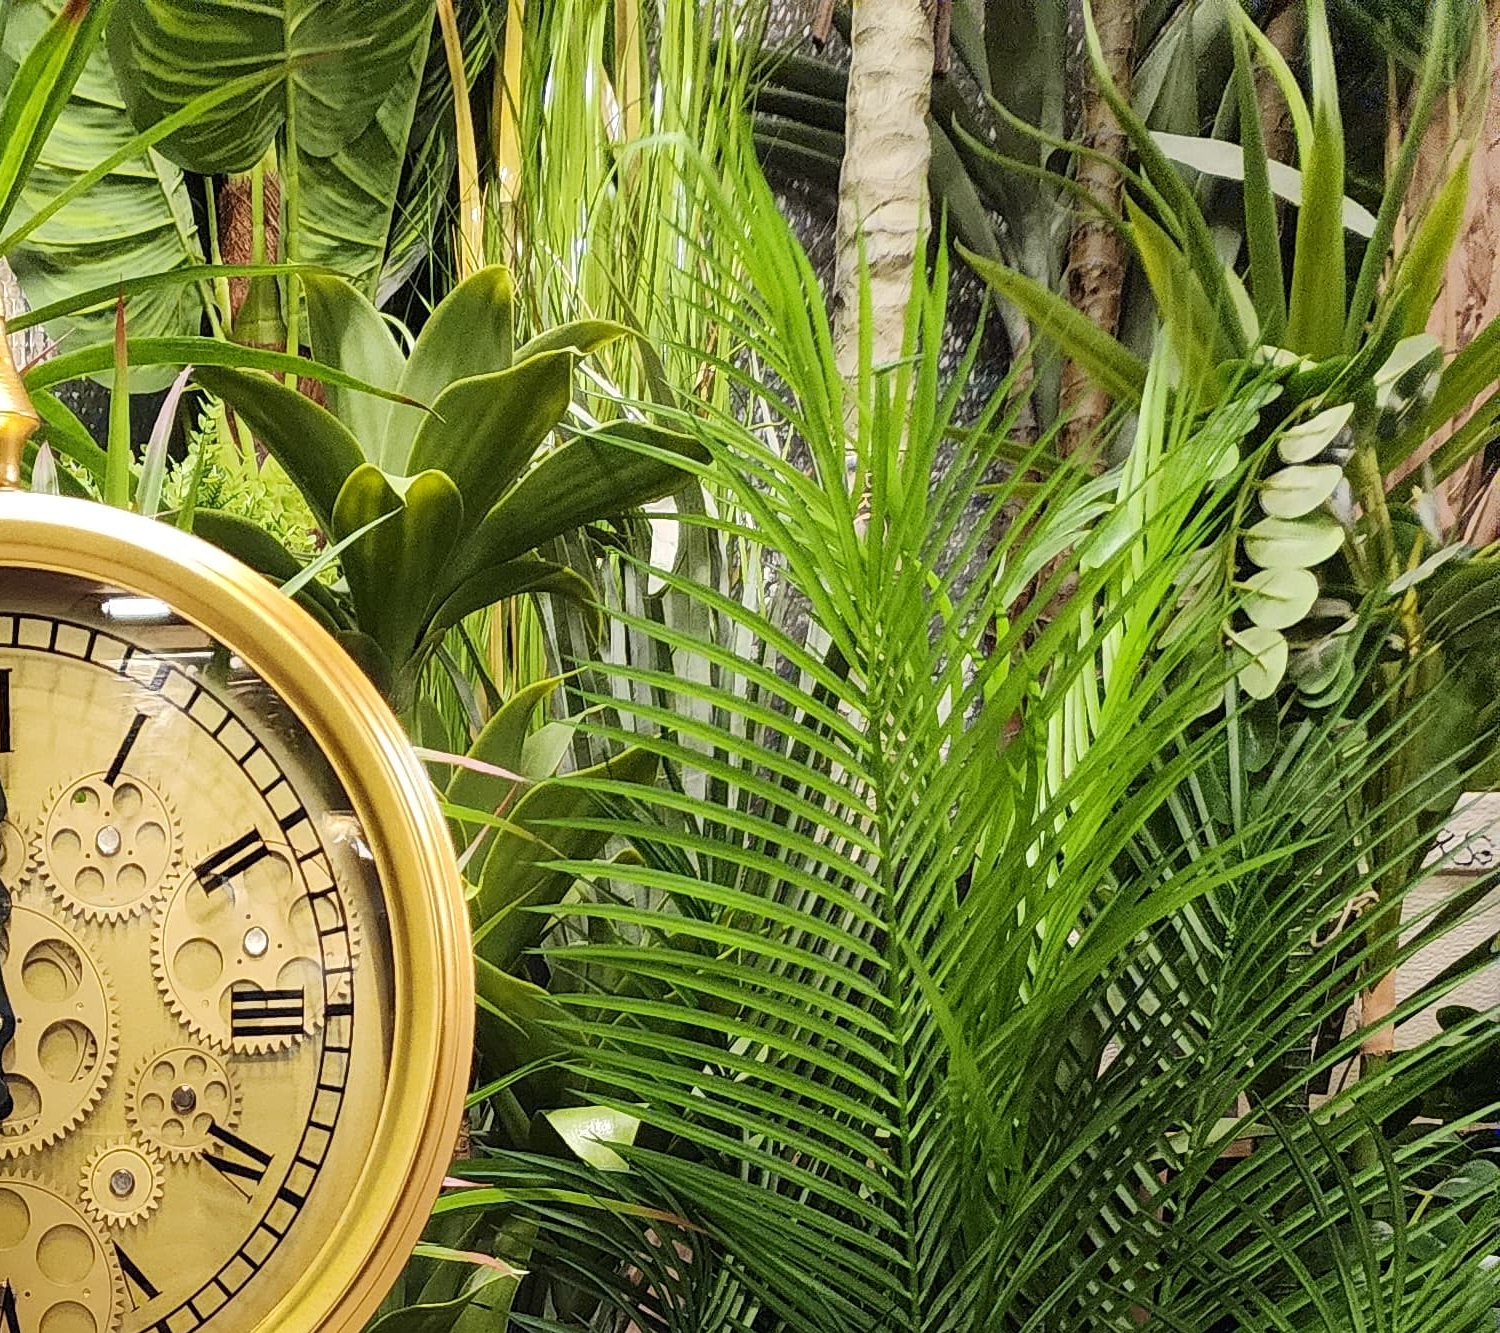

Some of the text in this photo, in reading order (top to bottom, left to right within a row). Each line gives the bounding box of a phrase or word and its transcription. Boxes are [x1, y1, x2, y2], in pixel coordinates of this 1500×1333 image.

[100, 707, 151, 789] I
[191, 823, 273, 898] II
[231, 984, 305, 1044] III
[200, 1120, 275, 1204] IV
[112, 1239, 163, 1313] V
